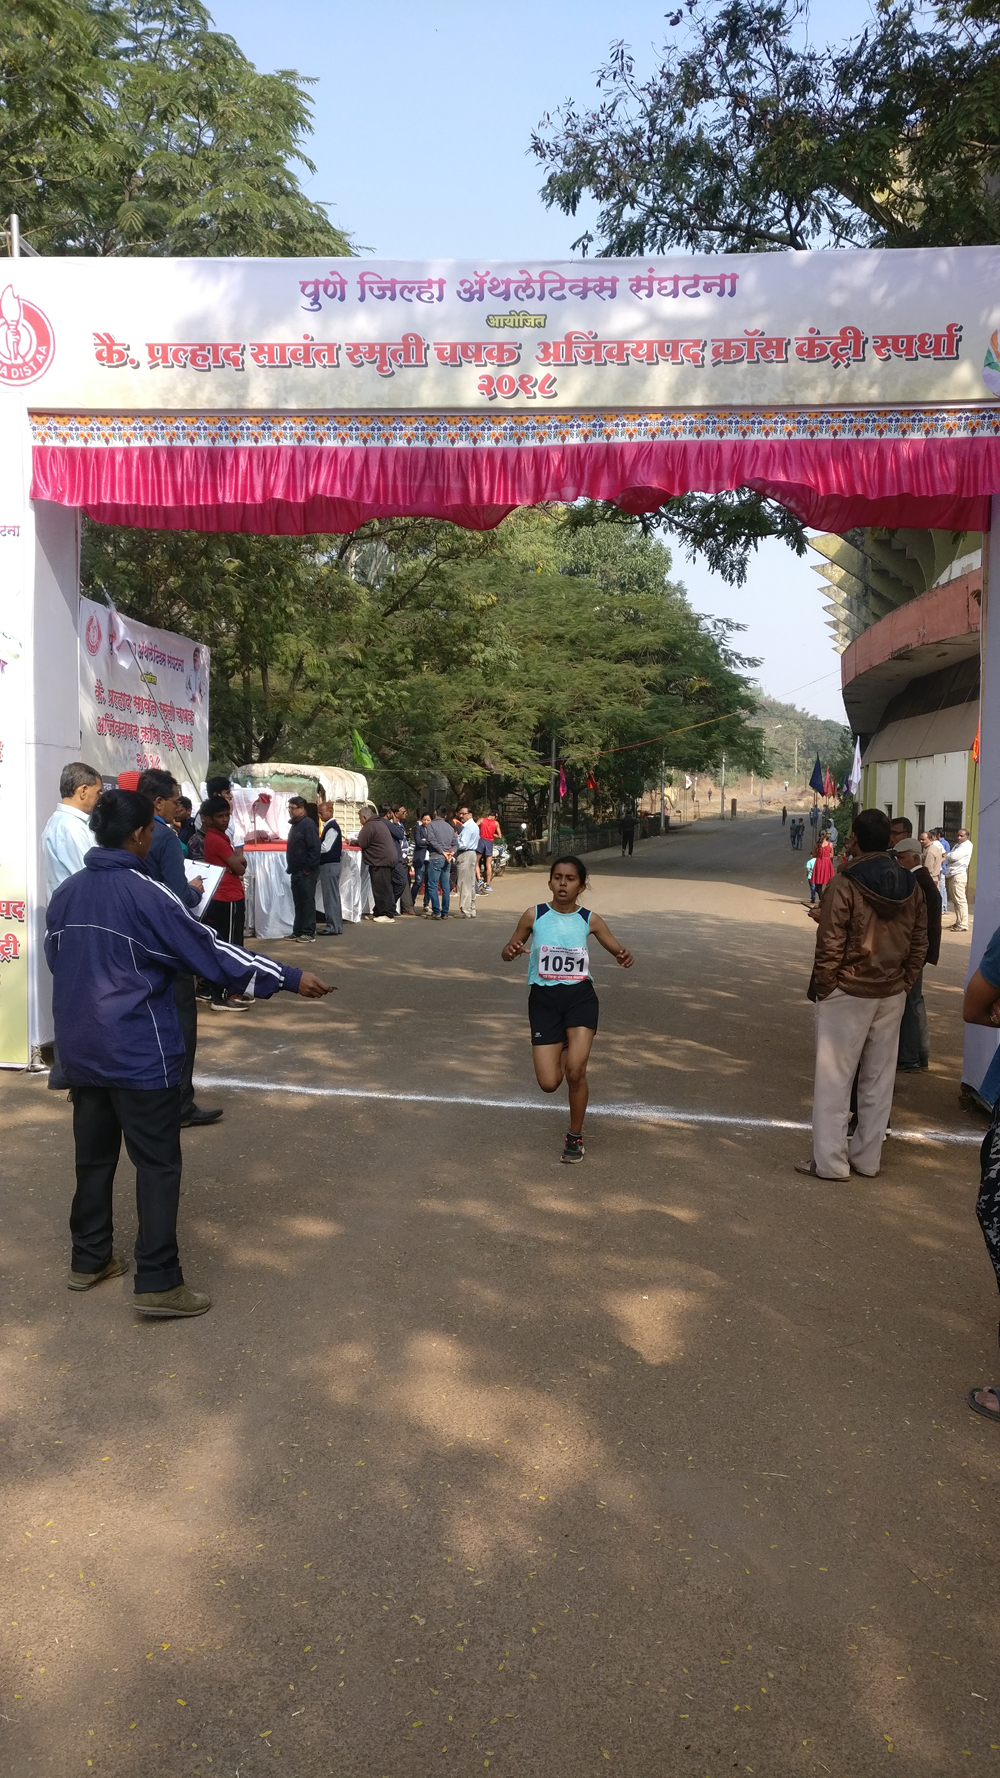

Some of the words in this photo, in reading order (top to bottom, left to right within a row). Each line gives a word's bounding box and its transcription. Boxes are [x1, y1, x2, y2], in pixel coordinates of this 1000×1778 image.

[299, 270, 348, 312] पुणे
[357, 270, 447, 304] जिल्हा
[628, 266, 740, 300] संघटना
[486, 310, 547, 329] आयोजित
[11, 361, 37, 379] DIST
[36, 345, 48, 363] AA
[92, 332, 139, 369] कै.
[145, 342, 245, 371] प्रल्हाद
[249, 332, 341, 368] सावंत
[345, 332, 429, 377] स्मृती
[433, 341, 521, 368] चषक
[535, 329, 707, 368] अजिंक्यपद
[711, 328, 791, 367] क्रॉस
[794, 325, 869, 369] कंट्री
[872, 322, 963, 361] स्पर्धा
[477, 371, 557, 400] २०१८
[541, 955, 585, 973] 1051
